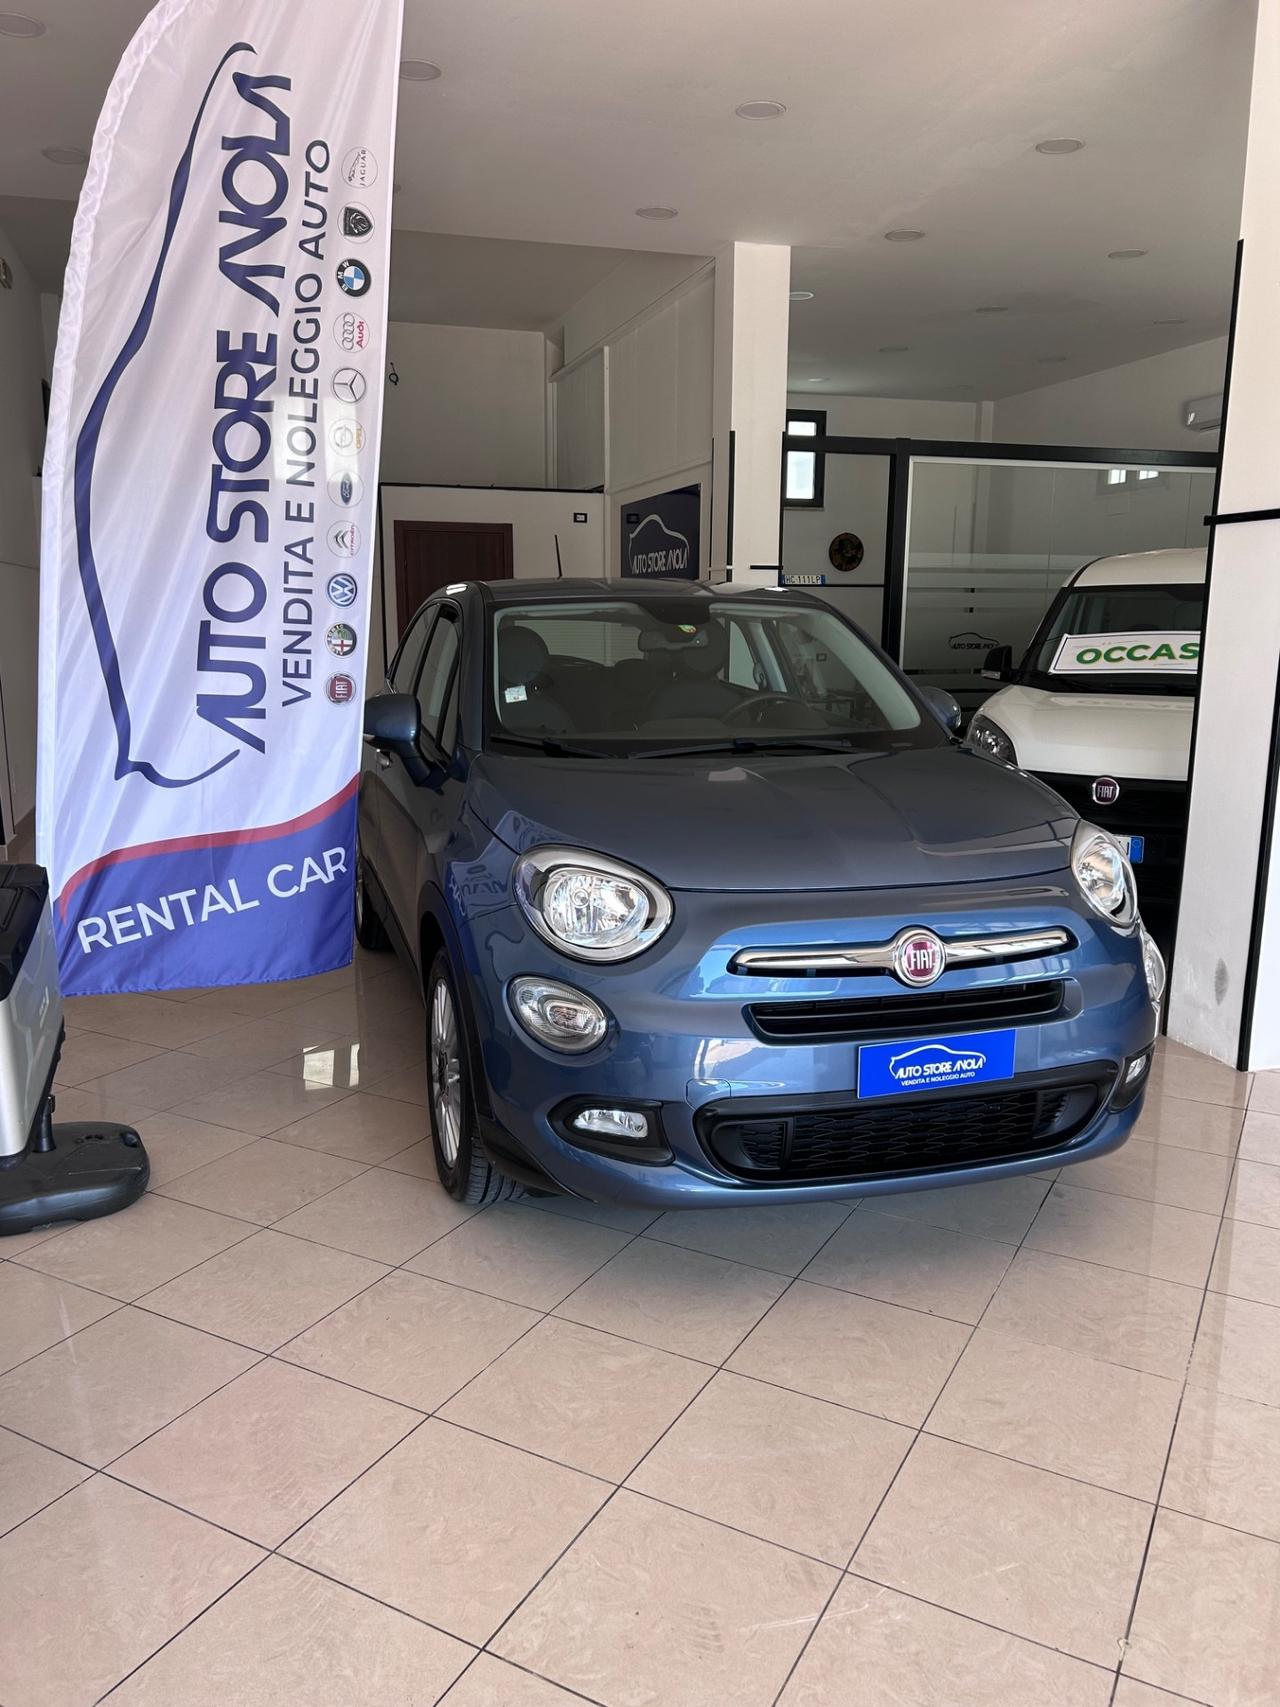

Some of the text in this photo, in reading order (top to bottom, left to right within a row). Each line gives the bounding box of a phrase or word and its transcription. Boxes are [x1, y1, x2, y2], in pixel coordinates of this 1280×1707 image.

[359, 149, 368, 186] JAGUAR
[337, 260, 350, 292] BMW
[356, 321, 365, 348] Audi
[206, 329, 278, 543] STORE
[281, 139, 331, 707] VENDITA E NOLEGGIO AUTO
[632, 554, 648, 575] AUTO
[648, 550, 666, 573] STORE
[196, 562, 267, 754] AUTO
[335, 680, 348, 699] FIAT
[1097, 785, 1115, 799] FIAT
[78, 847, 348, 954] RENTAL CAR
[909, 948, 934, 971] FIAT
[895, 1065, 922, 1080] AUTO
[923, 1060, 953, 1076] STORE
[901, 1078, 926, 1087] VENDITA
[931, 1073, 959, 1082] NOLEGGIO
[960, 1071, 976, 1079] AUTO
